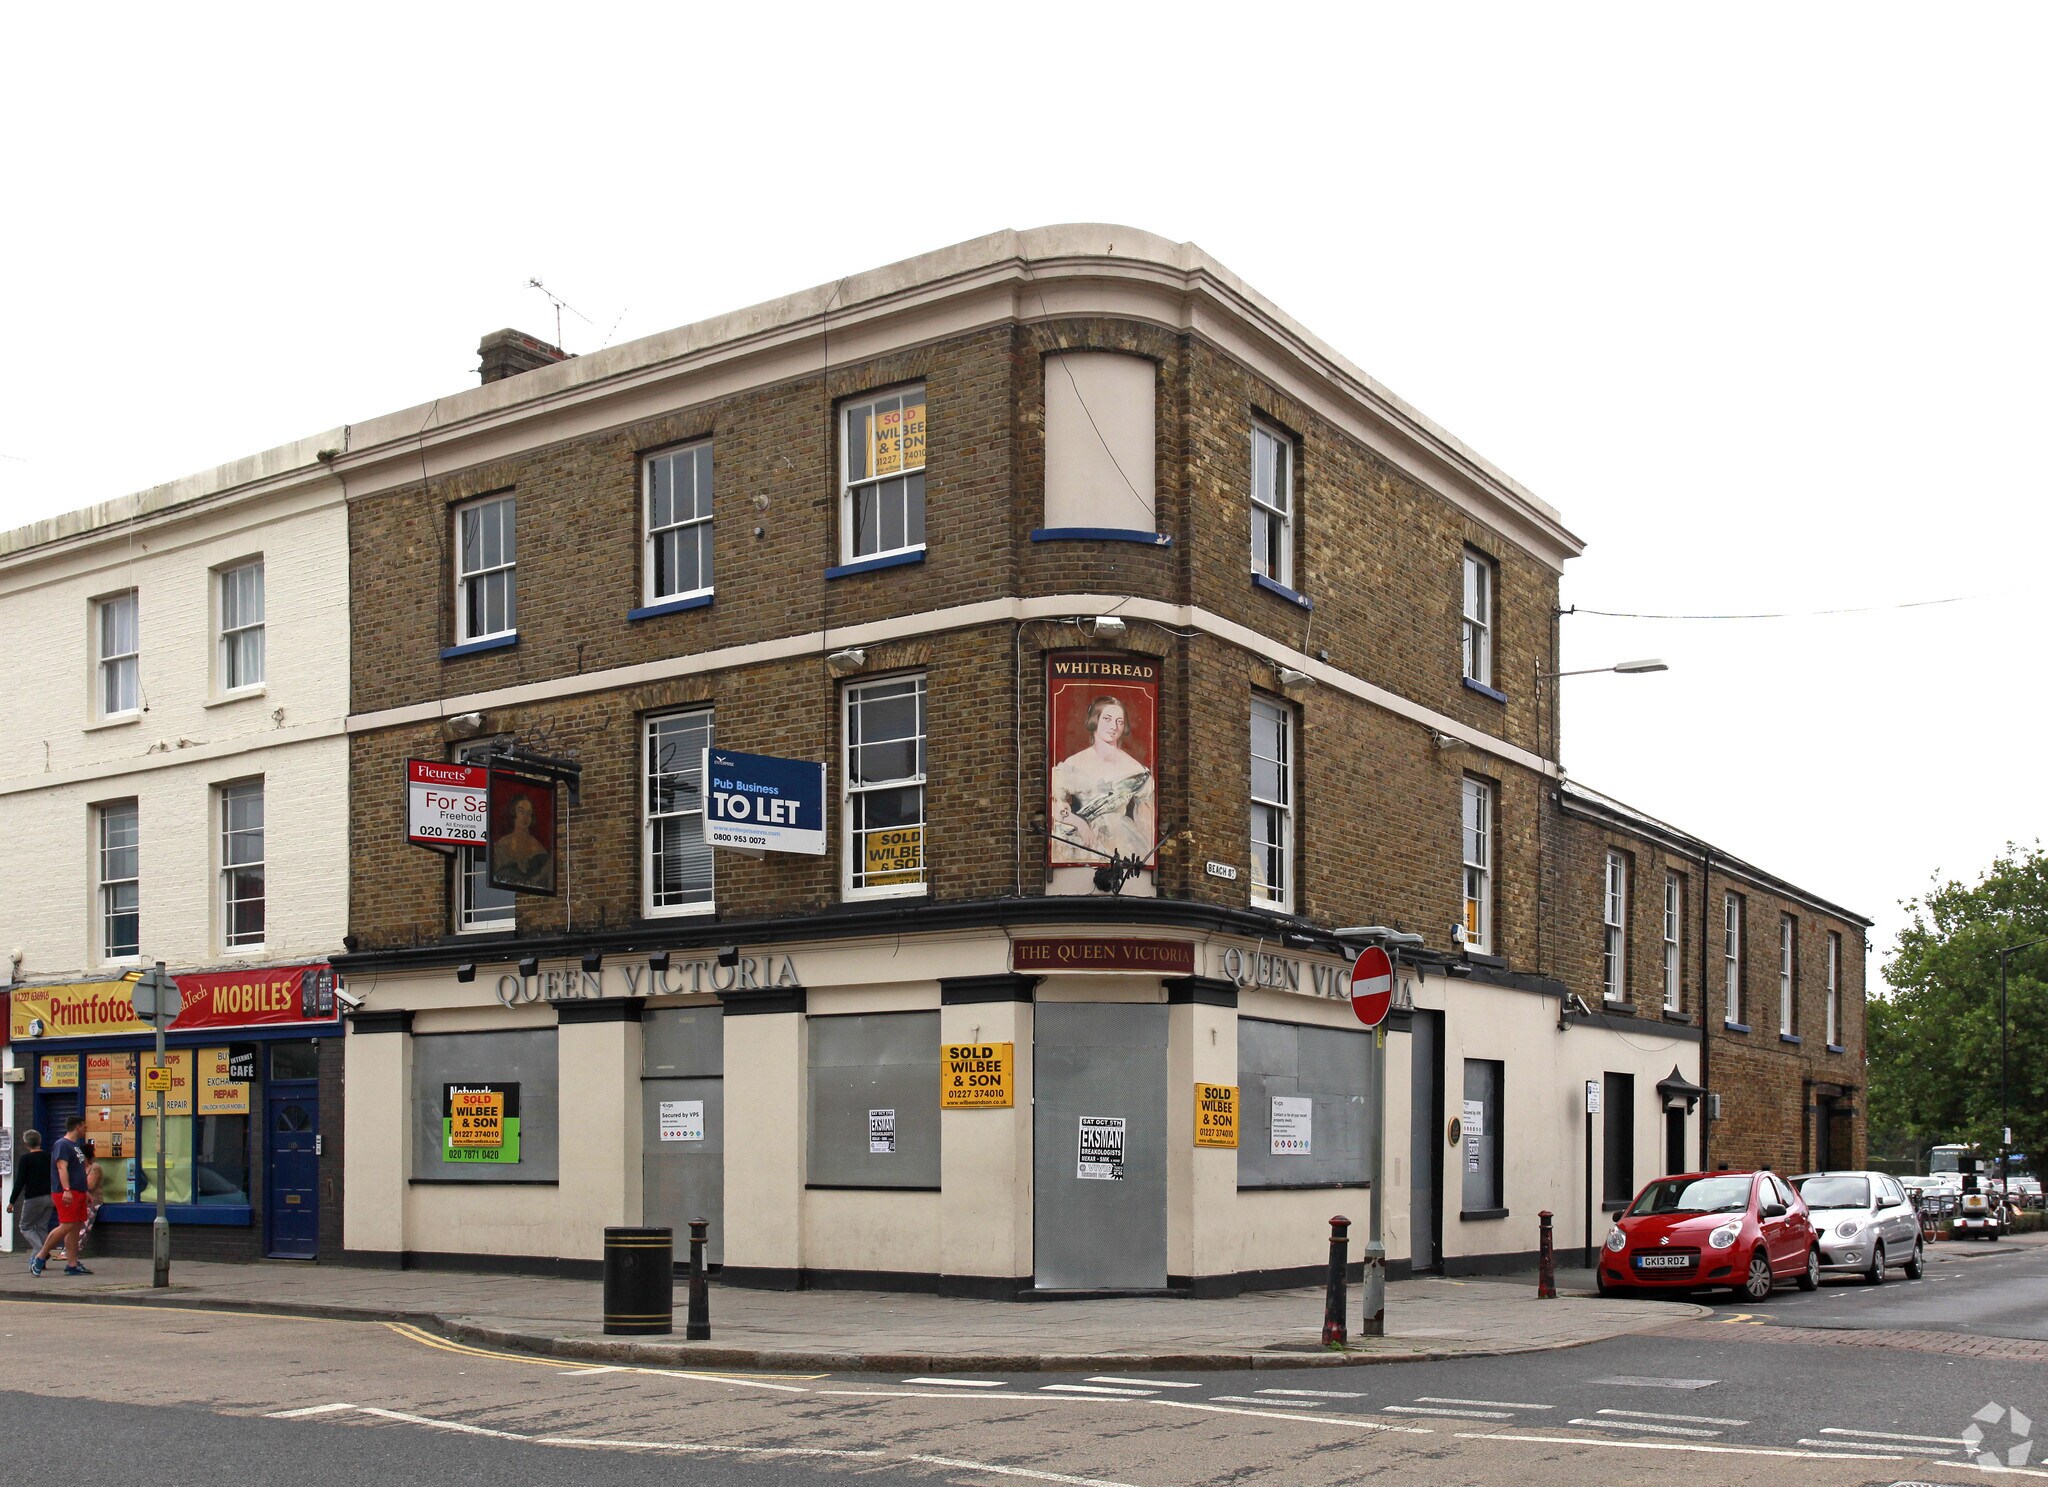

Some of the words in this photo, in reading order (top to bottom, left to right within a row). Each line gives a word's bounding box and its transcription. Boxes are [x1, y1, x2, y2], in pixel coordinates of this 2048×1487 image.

[876, 421, 924, 441] WILBEE
[879, 443, 889, 454] &
[894, 435, 924, 451] SON
[899, 449, 926, 461] 74010
[1055, 663, 1153, 678] WHITBREAD
[418, 765, 466, 781] Fleurets
[713, 777, 734, 790] Pub
[736, 781, 779, 795] Business
[426, 792, 457, 810] For
[464, 795, 487, 813] Sa
[713, 792, 751, 819] TO
[757, 797, 800, 825] LET
[440, 811, 482, 822] Freehold
[420, 826, 442, 837] 020
[446, 828, 476, 839] 7280
[713, 825, 781, 837] www.enterpriseinns.com
[713, 833, 732, 842] 0800
[734, 835, 747, 843] 953
[749, 837, 766, 845] 0072
[881, 832, 921, 846] SOLD
[881, 863, 889, 872] &
[1208, 863, 1227, 876] BEACH
[1018, 946, 1050, 959] THE
[1057, 945, 1115, 962] QUEEN
[1123, 946, 1190, 963] VICTORIA
[495, 968, 603, 1010] QUEEN
[620, 954, 801, 996] VICTORIA
[1224, 947, 1300, 991] QUEEN
[1311, 962, 1416, 1010] VICIA
[212, 981, 292, 1014] MOBILES
[230, 1053, 253, 1063] INTERNET
[949, 1047, 993, 1059] SOLD
[88, 1057, 110, 1067] Kodak
[153, 1055, 180, 1065] LTOPS
[216, 1064, 229, 1073] SEL
[230, 1064, 254, 1077] CAFÉ
[950, 1061, 1001, 1073] WILBEE
[953, 1075, 964, 1087] &
[969, 1074, 1001, 1086] SON
[213, 1089, 238, 1099] REPAIR
[948, 1090, 972, 1098] 01227
[974, 1089, 1004, 1098] 374010
[1204, 1087, 1231, 1099] SOLD
[166, 1100, 188, 1109] REPAIR
[463, 1095, 492, 1104] SOLD
[456, 1107, 498, 1116] WILBEE
[1201, 1101, 1232, 1113] WILBEE
[462, 1118, 470, 1127] &
[473, 1118, 498, 1127] SON
[1203, 1113, 1210, 1125] &
[1213, 1114, 1232, 1126] SON
[1082, 1127, 1121, 1149] EKSMAN
[1200, 1128, 1215, 1137] 01227
[1216, 1129, 1233, 1138] 374010
[449, 1150, 462, 1159] 020
[464, 1150, 479, 1159] 7871
[482, 1150, 499, 1160] 0420
[1081, 1148, 1121, 1156] BREAKOLOGISTS
[1645, 1257, 1665, 1266] GK13
[1667, 1256, 1685, 1265] RDZ
